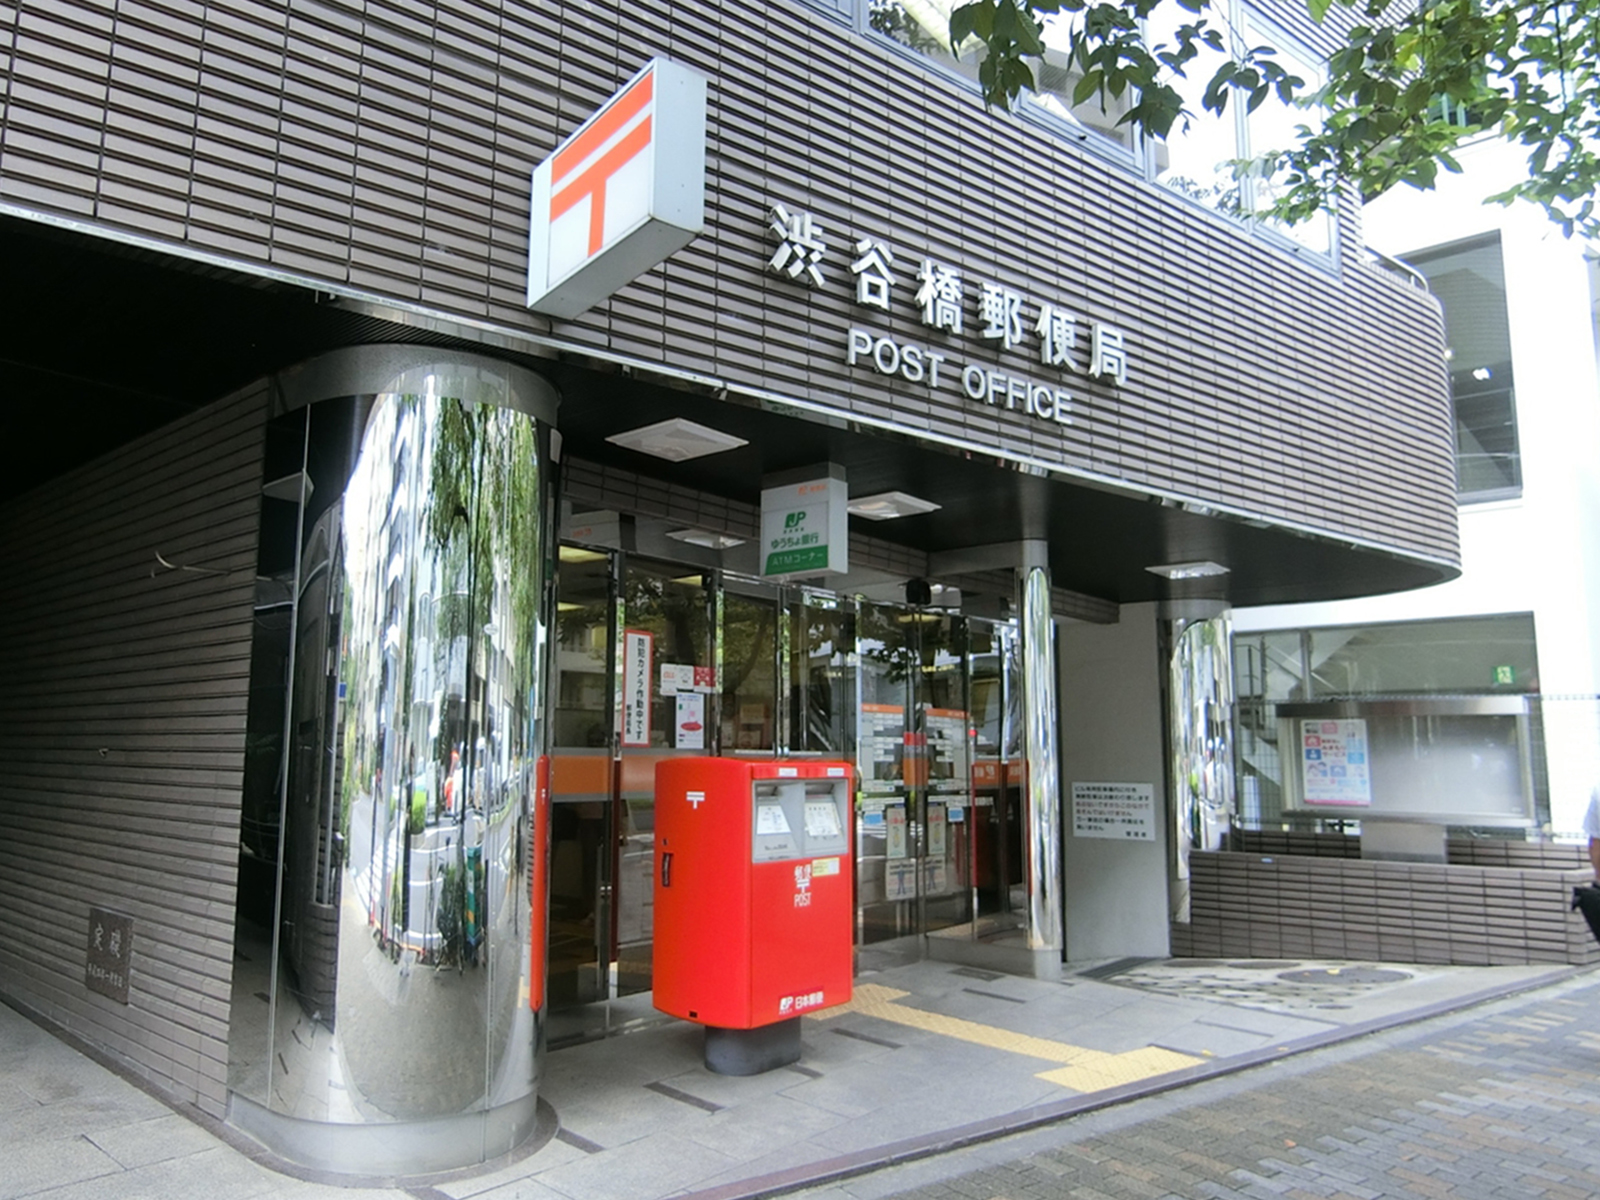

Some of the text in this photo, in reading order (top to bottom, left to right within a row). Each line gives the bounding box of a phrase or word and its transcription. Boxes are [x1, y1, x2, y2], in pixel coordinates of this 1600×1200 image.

[768, 203, 1128, 387] 渋谷橋郵便局
[847, 328, 1073, 426] POST OFFICE
[771, 532, 819, 549] ゆうちょ銀行
[772, 552, 823, 566] ATMコーナー
